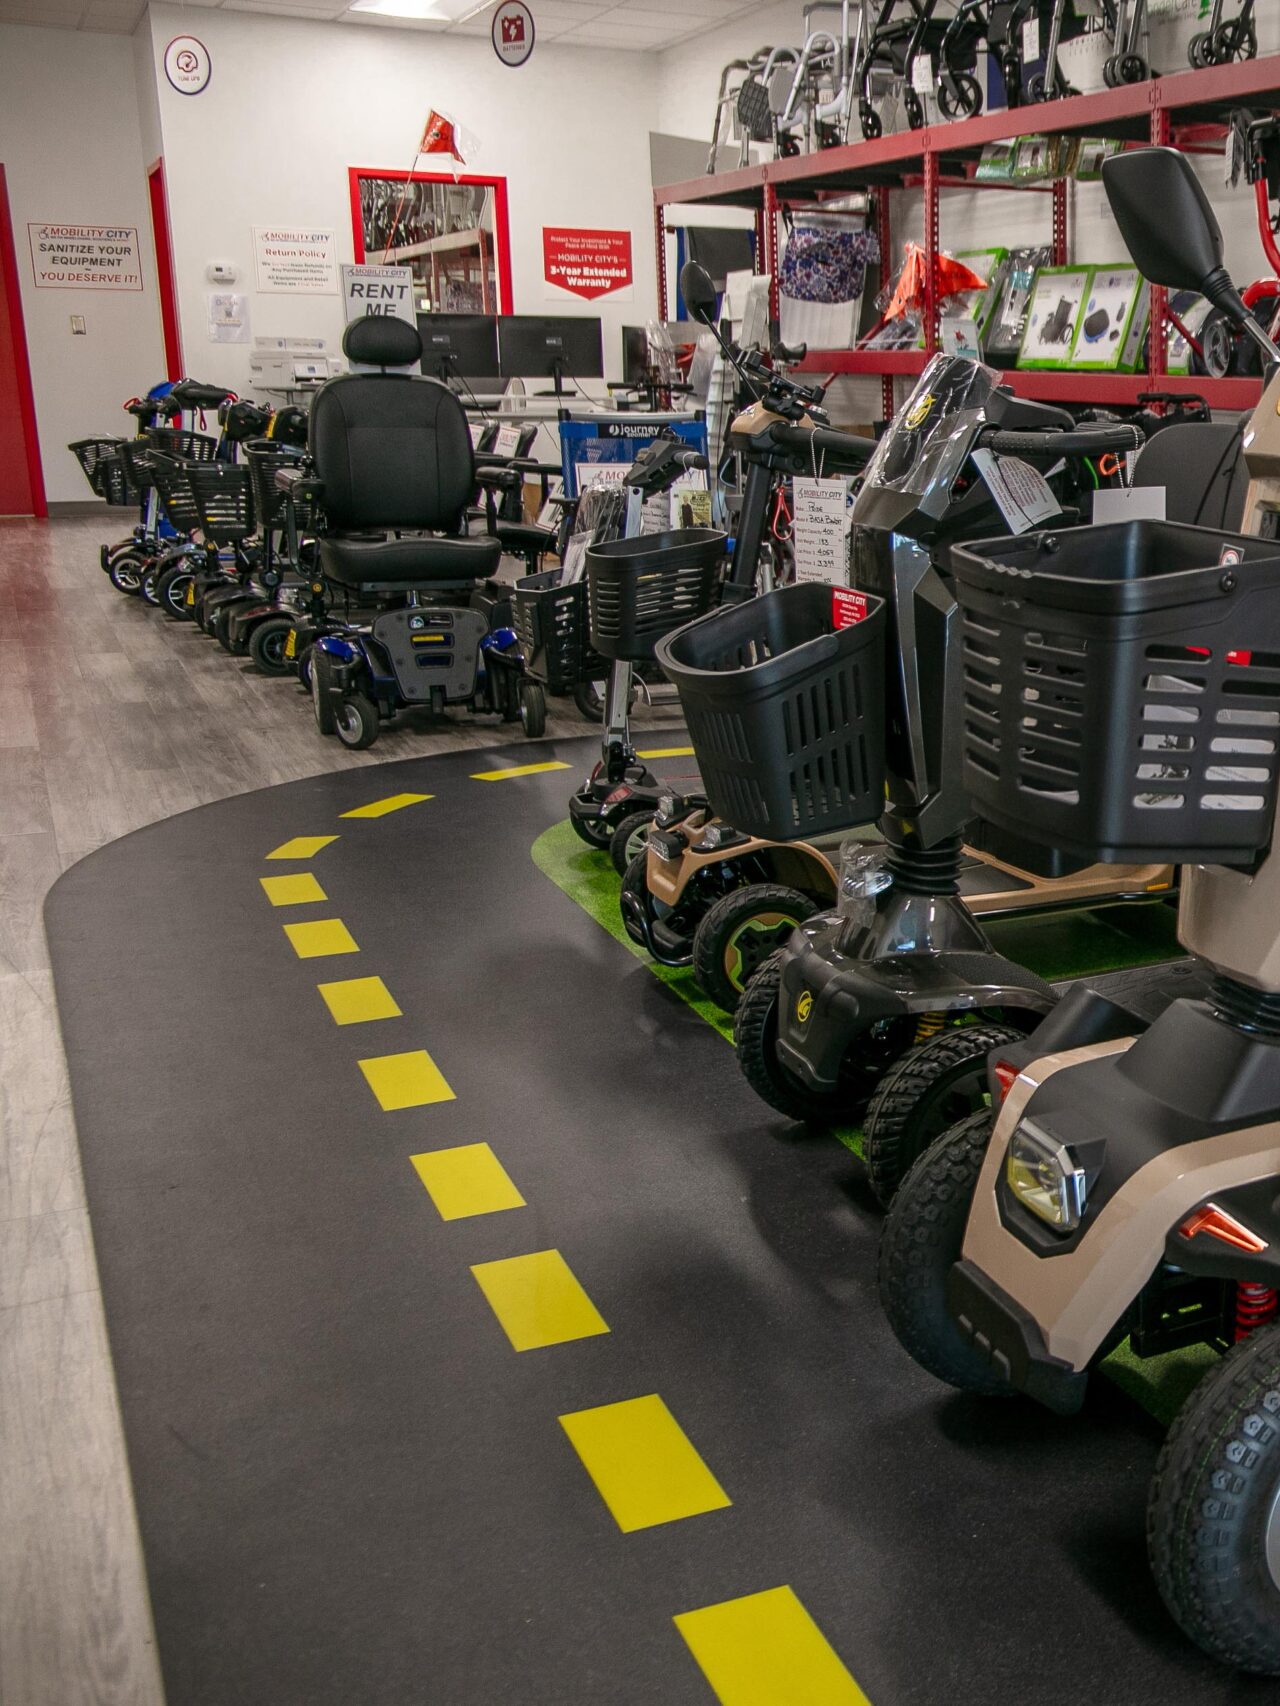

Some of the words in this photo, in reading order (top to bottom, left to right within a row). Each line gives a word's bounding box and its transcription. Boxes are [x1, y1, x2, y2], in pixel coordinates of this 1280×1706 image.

[50, 227, 104, 237] MOBILITY
[106, 230, 132, 238] CITY
[270, 232, 310, 241] MOBILITY
[39, 243, 94, 254] SANITIZE
[98, 246, 131, 255] YOUR
[265, 248, 296, 257] Return
[299, 249, 326, 259] Policy
[51, 256, 123, 267] EQUIPMENT
[558, 253, 593, 263] MOBILITY
[355, 267, 389, 276] MOBILITY
[391, 269, 407, 277] CITY
[550, 265, 581, 275] 3-Year
[582, 266, 627, 278] Extended
[40, 271, 65, 281] YOU
[68, 272, 121, 283] DESERVE
[124, 274, 138, 284] IT!
[567, 276, 611, 288] Warranty
[350, 283, 409, 299] RENT
[620, 423, 660, 436] journey
[829, 491, 842, 499] CITY
[834, 591, 855, 603] MOBILITY
[856, 596, 866, 606] CITY
